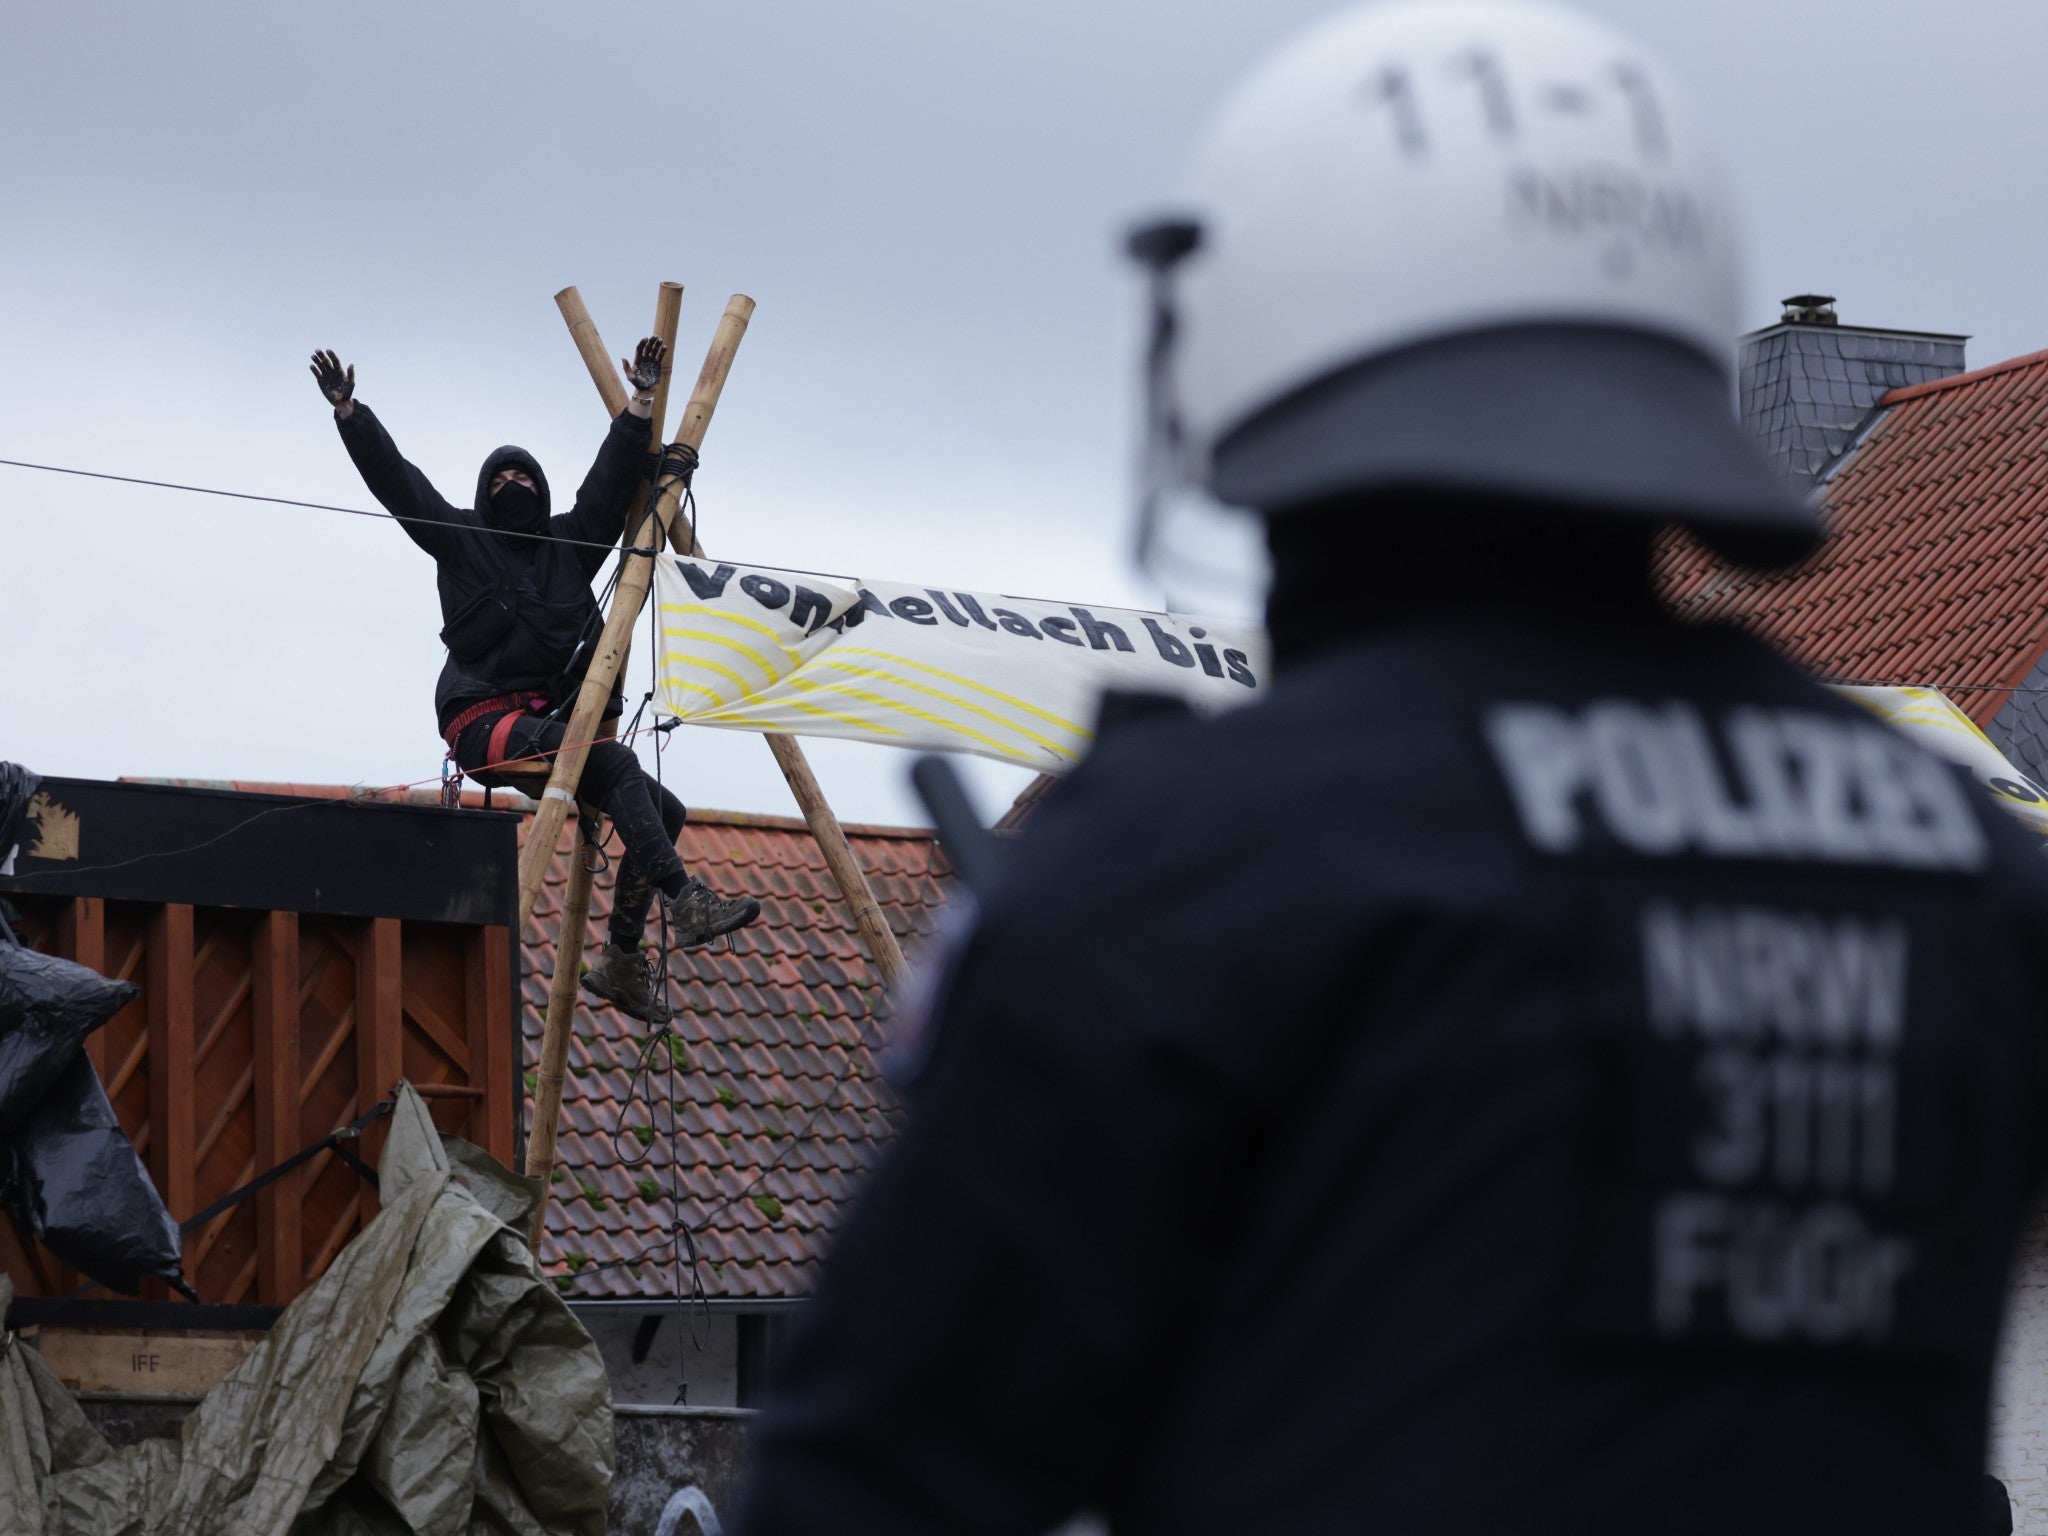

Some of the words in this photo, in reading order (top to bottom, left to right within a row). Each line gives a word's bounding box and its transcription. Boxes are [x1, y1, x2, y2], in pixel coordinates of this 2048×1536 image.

[674, 560, 832, 638] Von
[1140, 617, 1257, 689] bis
[1488, 702, 1988, 870] POLIZEI
[1642, 905, 1908, 1045] NRW
